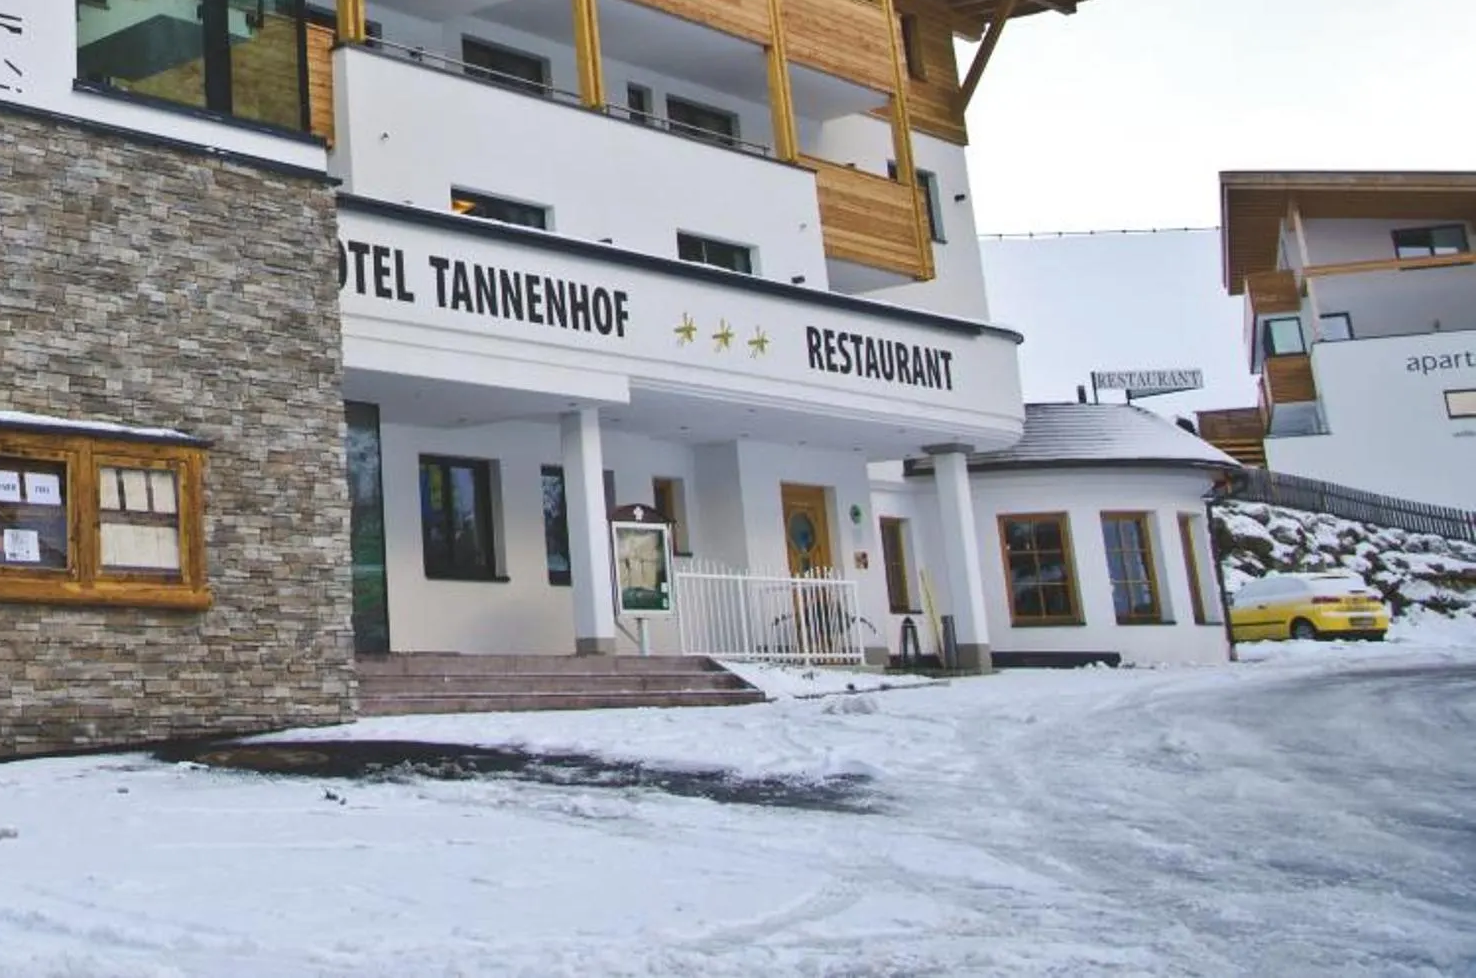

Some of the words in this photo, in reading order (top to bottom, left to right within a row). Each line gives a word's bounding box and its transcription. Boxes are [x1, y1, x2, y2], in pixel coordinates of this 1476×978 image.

[428, 255, 630, 338] TANNENHOF
[806, 326, 953, 390] RESTAURANT
[1096, 369, 1201, 389] RESTAURANT
